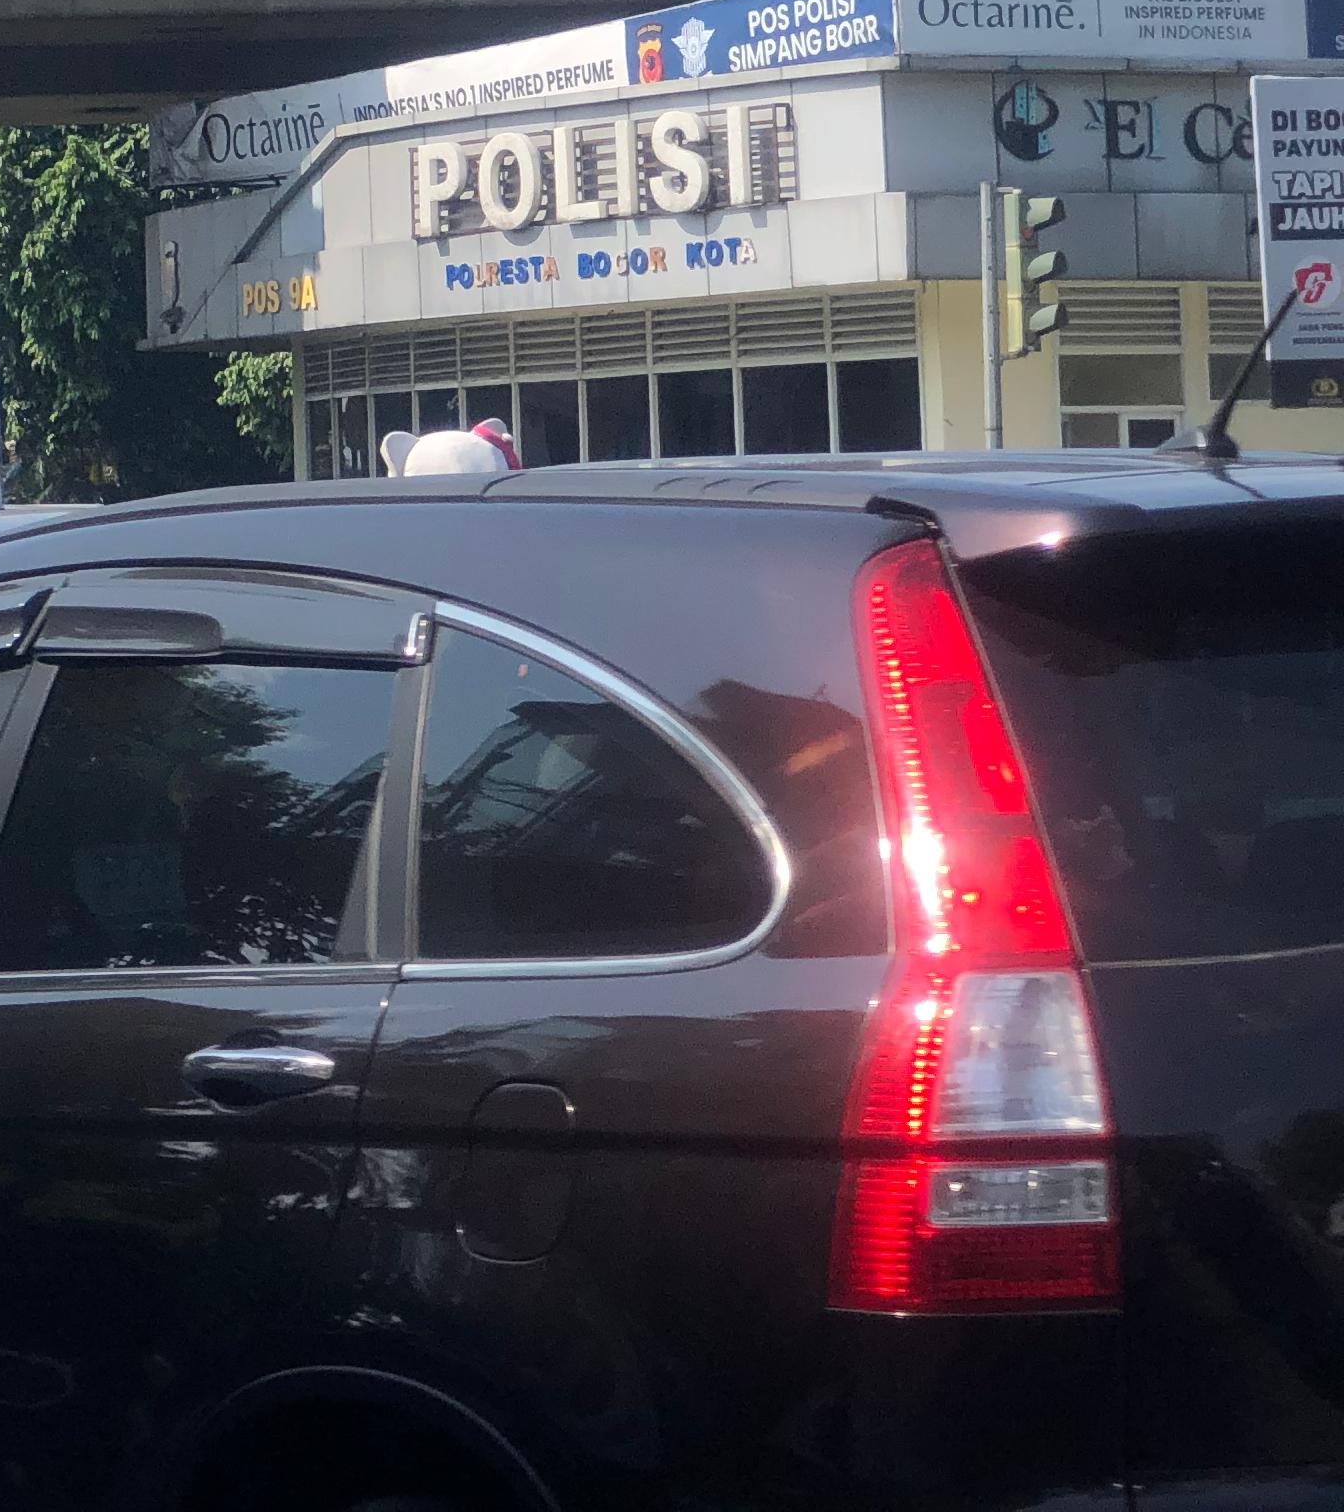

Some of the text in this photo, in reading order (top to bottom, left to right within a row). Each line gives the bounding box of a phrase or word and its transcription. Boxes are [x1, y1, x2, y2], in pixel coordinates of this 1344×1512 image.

[748, 4, 790, 37] POS
[1124, 6, 1265, 21] INSPIRED PERFUME
[1138, 25, 1252, 40] IN INDONESIA
[728, 15, 880, 72] SIMPANG BORR
[445, 84, 476, 108] NO.1
[479, 75, 544, 105] INSPIRED
[546, 59, 614, 89] PERFUME
[1272, 109, 1344, 131] DI BO
[418, 105, 755, 237] POLISI
[1272, 170, 1343, 199] TAPI
[446, 237, 757, 291] POLRESTA BOGOR KOTA
[242, 274, 318, 317] POS 9A
